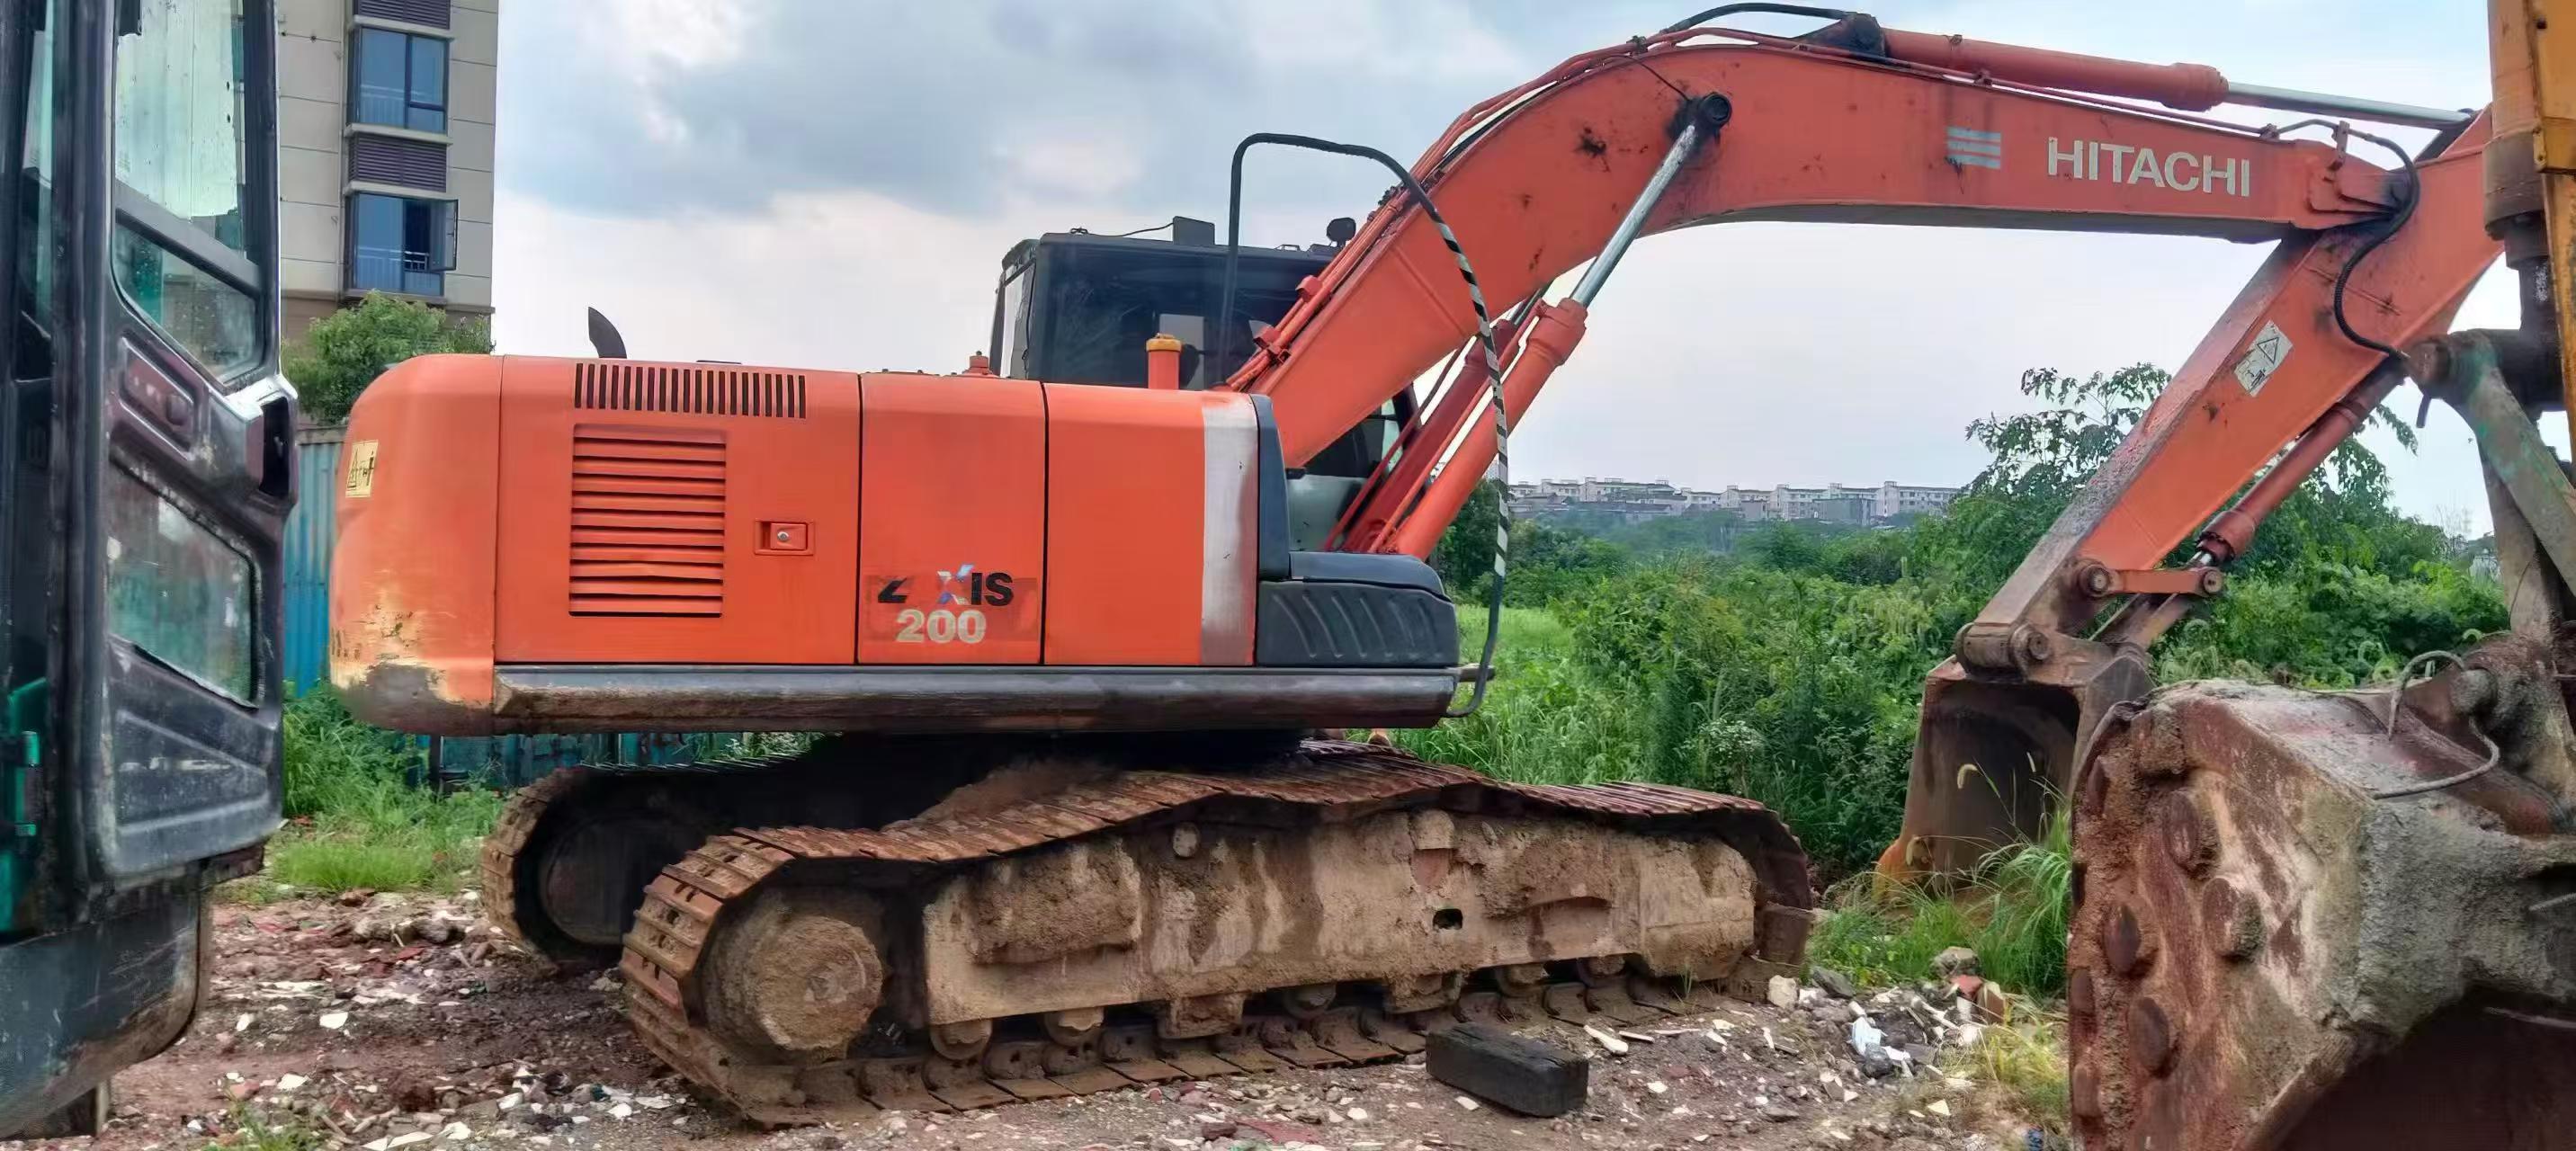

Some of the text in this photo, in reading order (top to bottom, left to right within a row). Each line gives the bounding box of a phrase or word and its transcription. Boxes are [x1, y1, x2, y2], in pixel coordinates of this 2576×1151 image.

[2048, 137, 2250, 197] HITACHI
[877, 563, 1015, 606] ZXIS
[896, 609, 987, 644] 200
